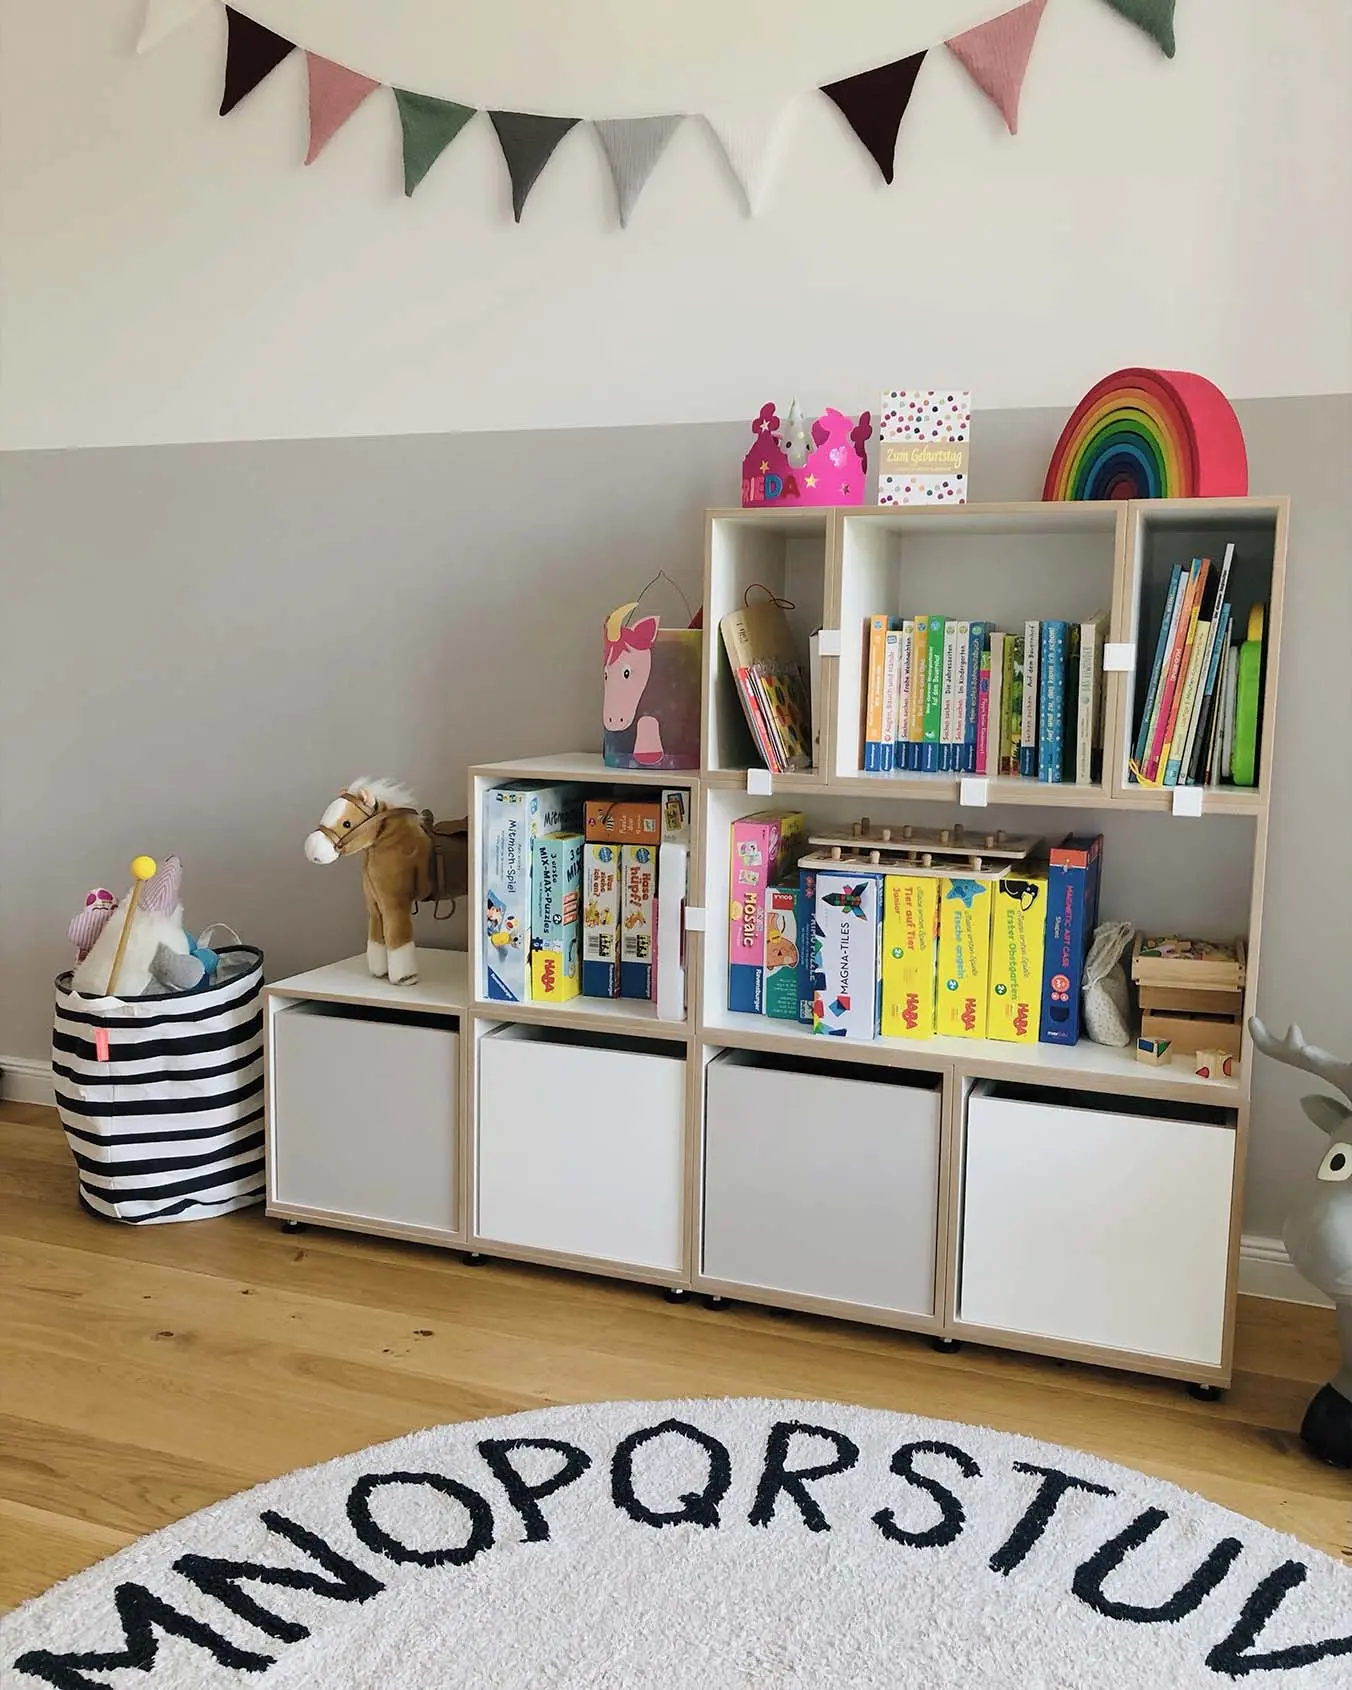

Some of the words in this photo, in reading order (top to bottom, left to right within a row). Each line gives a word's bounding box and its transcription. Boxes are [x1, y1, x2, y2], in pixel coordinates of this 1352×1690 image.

[887, 448, 909, 463] Zum
[911, 444, 962, 469] Geburtstag
[944, 643, 954, 683] Jahreszeiten
[507, 819, 517, 893] Mitmach-Spiel
[540, 847, 553, 934] MIX-MAX-Puzzles
[593, 884, 601, 897] an?
[628, 866, 642, 908] hüpf!
[643, 872, 651, 901] Hase
[892, 887, 901, 914] Junior
[904, 887, 914, 907] Tier
[743, 892, 758, 948] Mosaic
[905, 910, 915, 927] auf
[1064, 885, 1073, 927] MAGNETIC
[907, 931, 916, 950] Tier
[954, 911, 963, 942] Fische
[1006, 909, 1016, 940] Erster
[1063, 929, 1071, 945] ART
[840, 922, 850, 995] MAGNA-TILES
[1008, 943, 1018, 1000] Obstgarten
[1062, 946, 1070, 968] CASE
[541, 959, 556, 992] HABA
[754, 968, 762, 1011] Ravensburger
[902, 992, 919, 1030] HABA
[960, 998, 977, 1031] HABA
[1013, 1003, 1030, 1036] HABA
